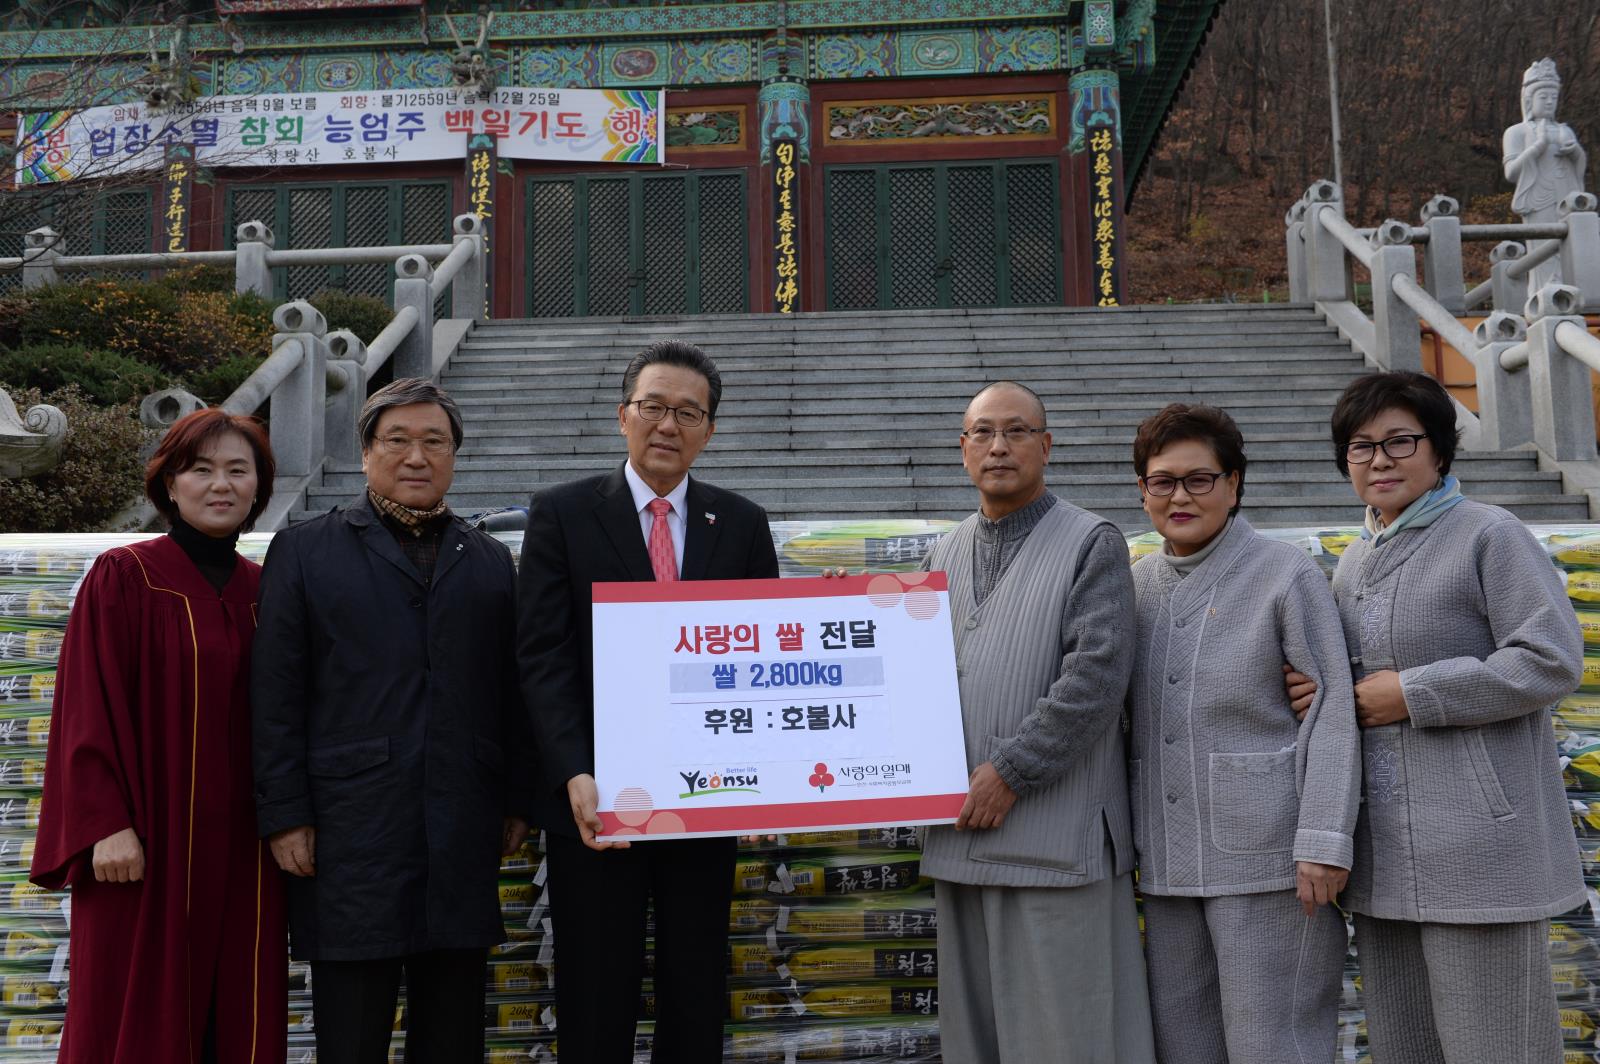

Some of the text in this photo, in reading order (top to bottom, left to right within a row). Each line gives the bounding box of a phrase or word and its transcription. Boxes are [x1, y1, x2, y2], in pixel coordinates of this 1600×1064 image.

[231, 98, 257, 113] 음력
[263, 97, 284, 113] 9월
[290, 96, 317, 111] 보름
[340, 95, 368, 109] 회향
[381, 92, 457, 109] 불기2559년
[529, 92, 561, 106] 25일
[89, 108, 587, 158] 업장소멸 참회 능엄주 백일기도
[609, 108, 641, 145] 행
[265, 144, 399, 164] 청량산 호불사
[674, 619, 877, 655] 사랑의 쌀 전달
[711, 661, 843, 690] 쌀 2,800kg
[704, 707, 754, 735] 후원
[781, 703, 857, 731] 호불사
[679, 769, 758, 794] Yeonsu
[837, 763, 911, 781] 사랑의 열매
[509, 1006, 533, 1019] 20kg
